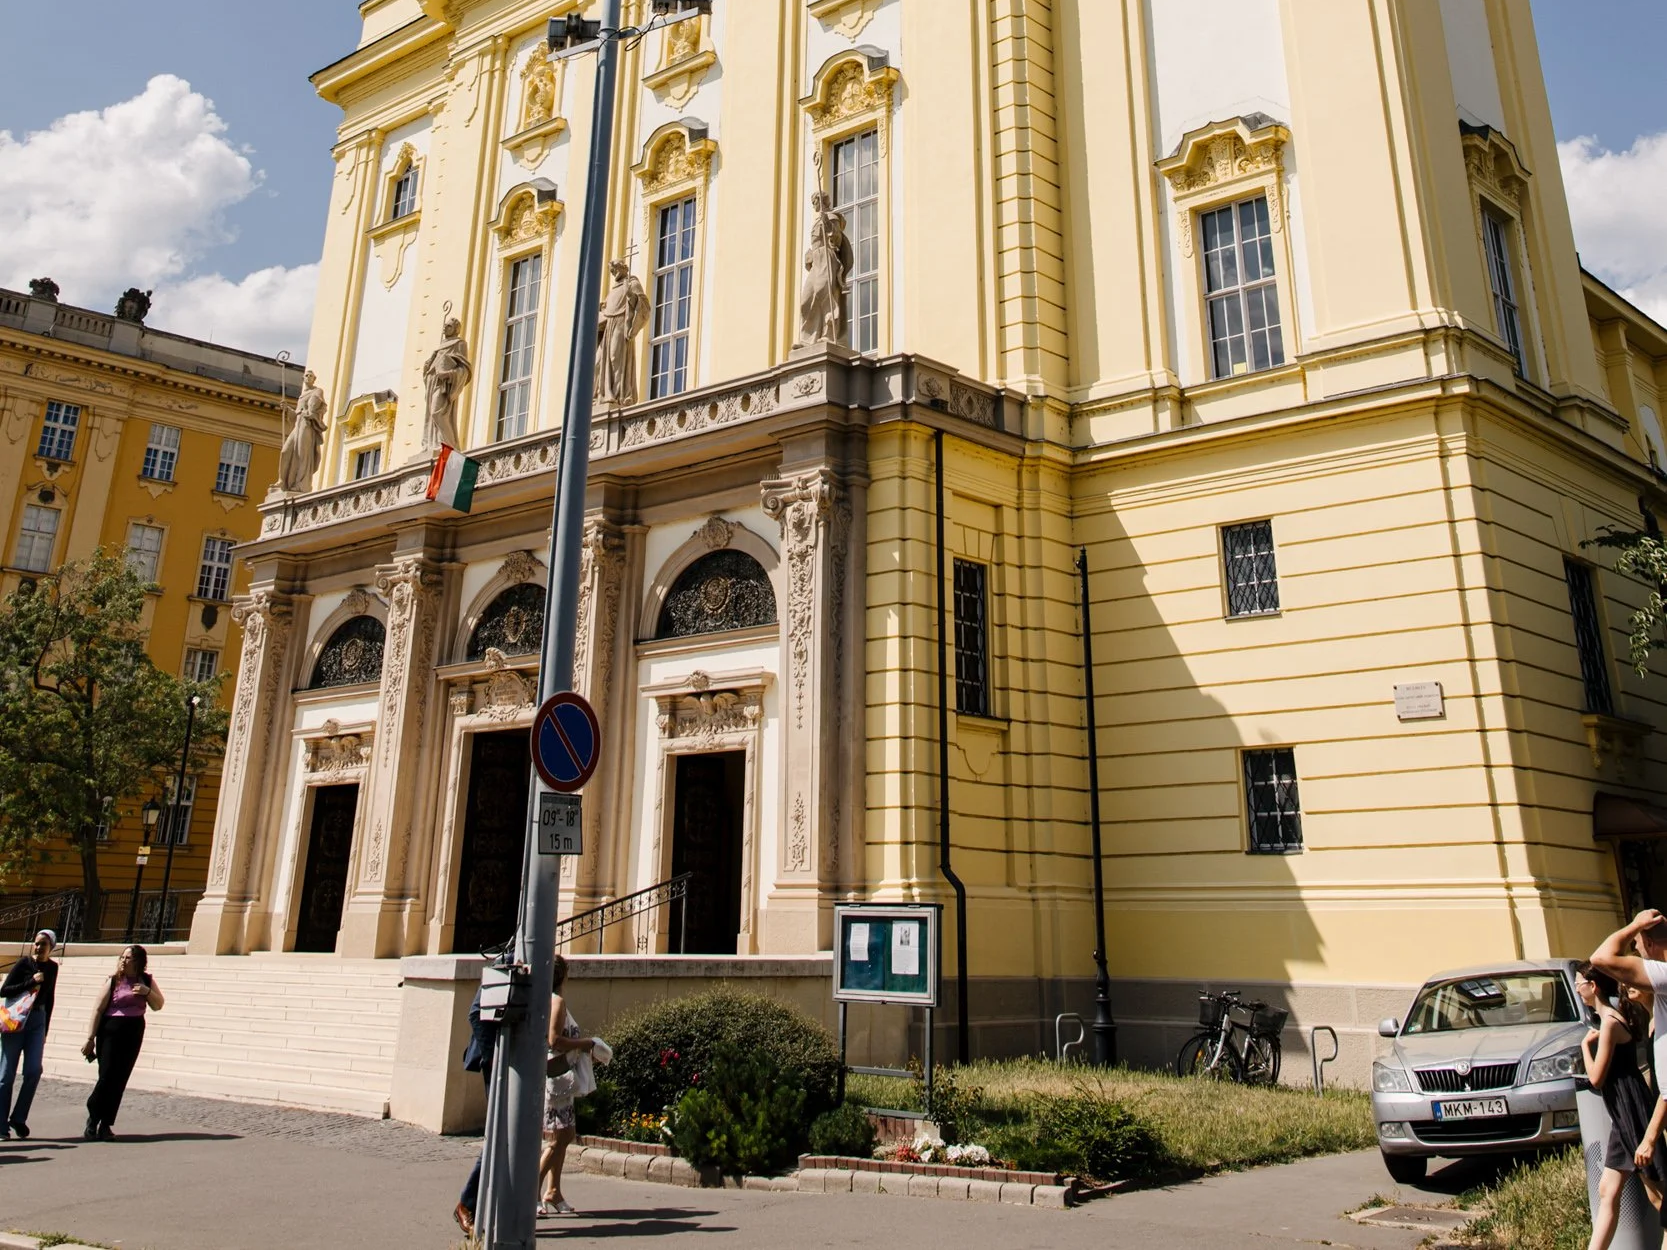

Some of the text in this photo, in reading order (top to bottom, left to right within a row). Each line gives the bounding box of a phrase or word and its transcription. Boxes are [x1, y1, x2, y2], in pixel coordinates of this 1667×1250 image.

[550, 834, 573, 850] 15 m
[1443, 1100, 1504, 1117] MKM-143
